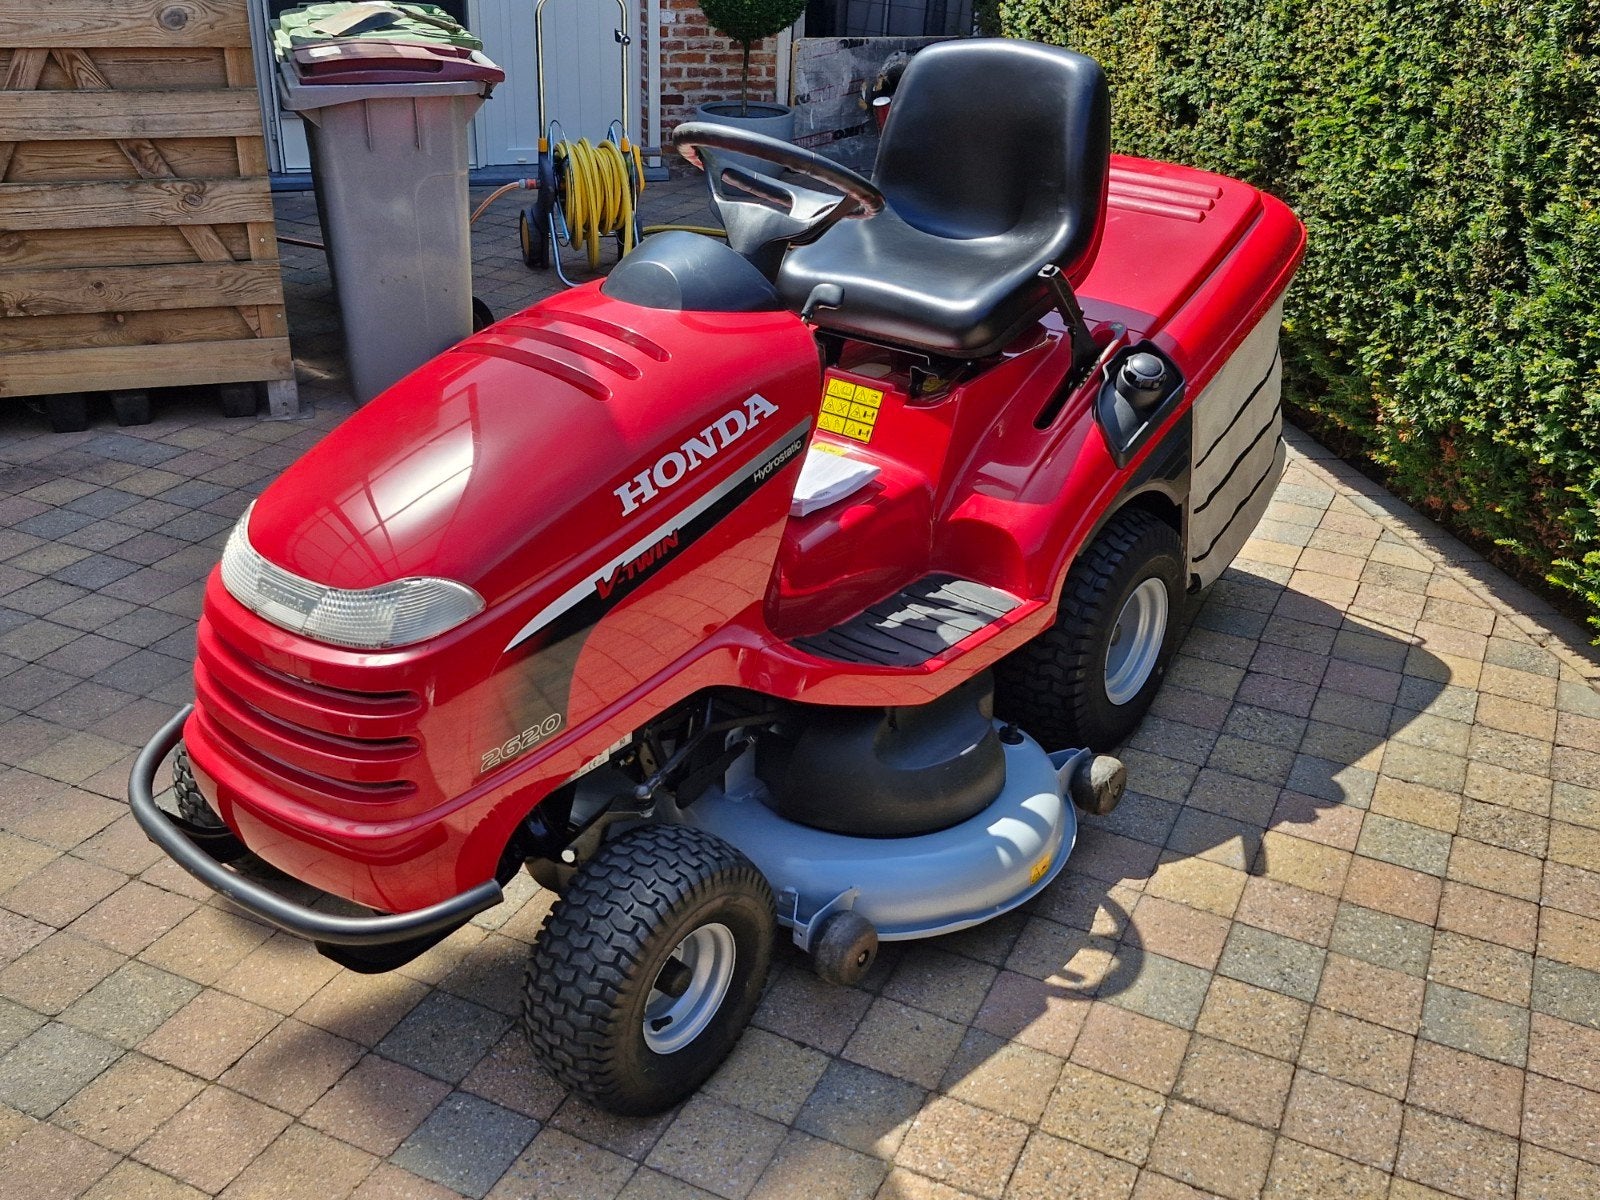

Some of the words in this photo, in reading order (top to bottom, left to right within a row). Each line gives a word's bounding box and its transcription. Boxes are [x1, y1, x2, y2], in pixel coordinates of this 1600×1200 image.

[613, 392, 779, 517] HONDA
[753, 440, 802, 483] Hydrostatic
[595, 528, 679, 600] V-TWIN
[480, 713, 562, 773] 2620
